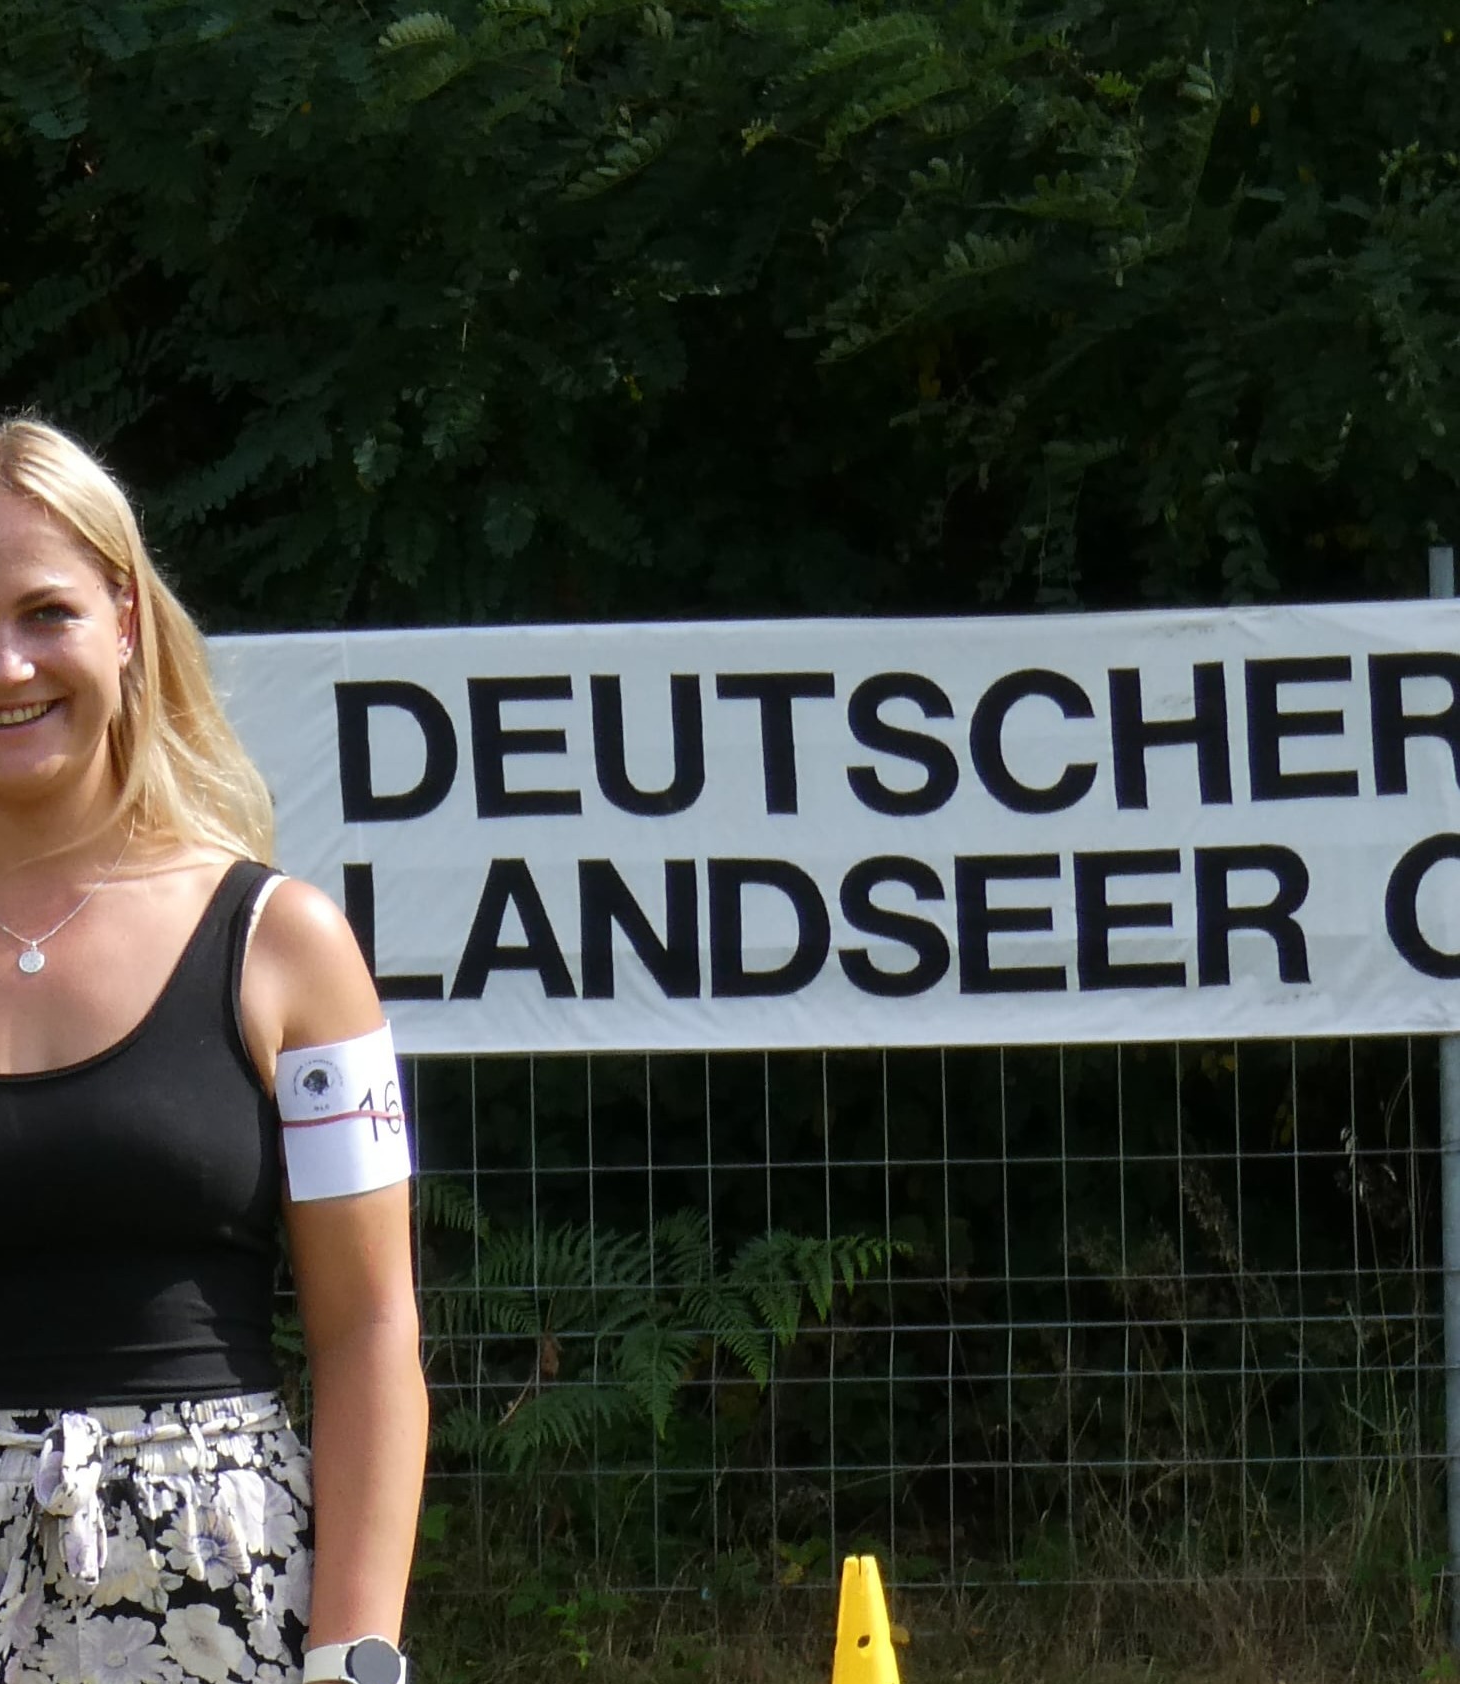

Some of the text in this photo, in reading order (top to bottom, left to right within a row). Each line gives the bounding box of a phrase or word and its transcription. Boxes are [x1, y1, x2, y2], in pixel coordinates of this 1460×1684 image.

[334, 652, 1460, 823] DEUTSCHER
[343, 844, 1311, 1001] LANDSEER
[359, 1080, 401, 1142] 16
